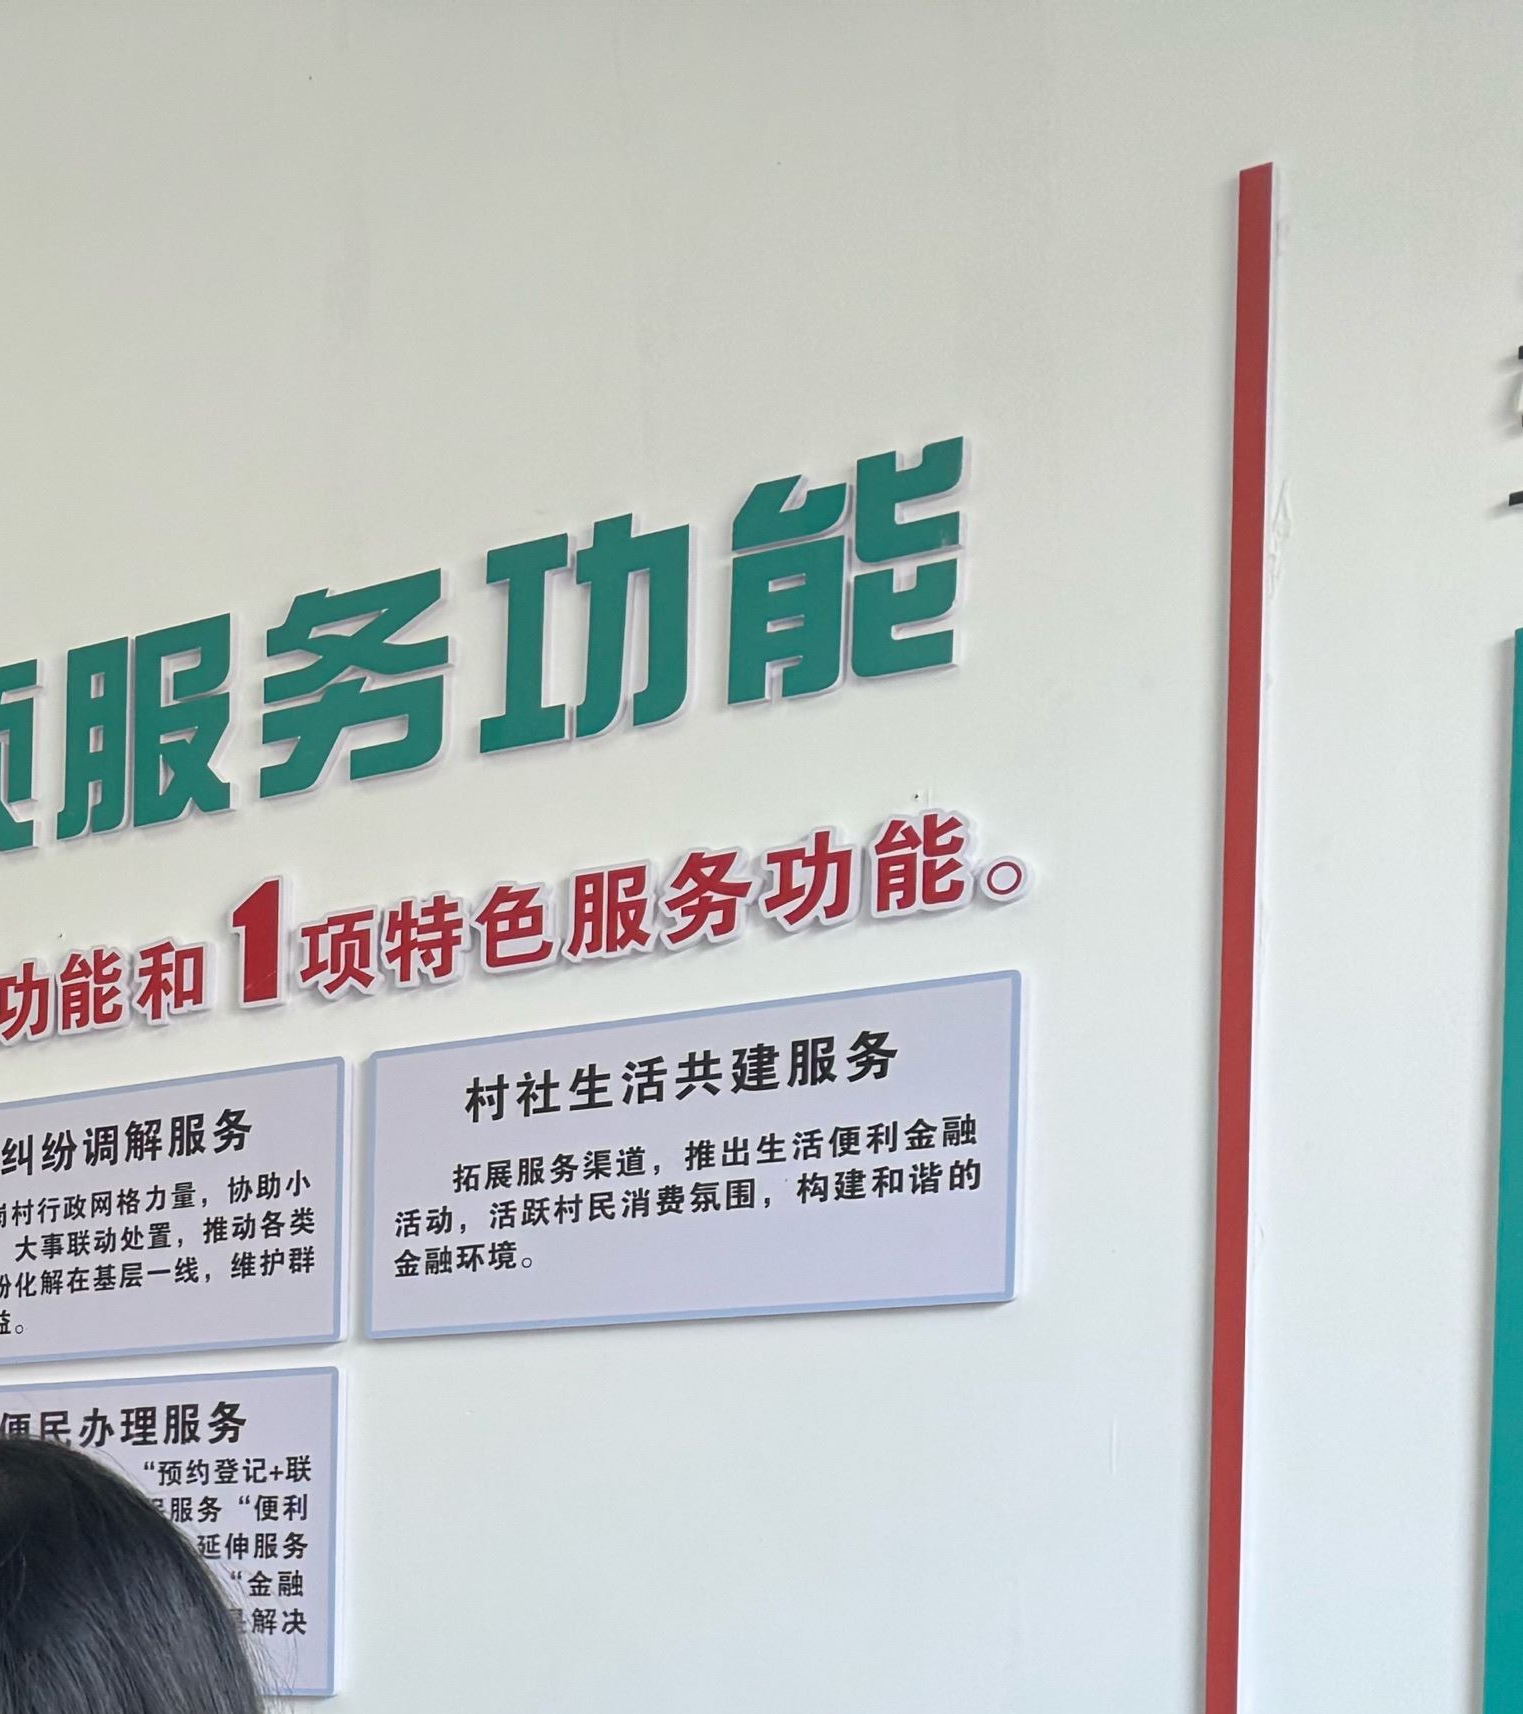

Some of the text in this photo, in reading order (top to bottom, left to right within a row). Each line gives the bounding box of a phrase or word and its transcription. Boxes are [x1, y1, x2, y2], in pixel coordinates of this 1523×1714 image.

[465, 1030, 899, 1122] 村社生活共建服务
[453, 1114, 977, 1193] 拓展服务渠道，推出生活便利金融
[395, 1158, 982, 1239] 活动，活跃村民消费氛围，构建和谐的
[394, 1240, 535, 1278] 金融环境。
[197, 1532, 308, 1561] 延伸服务
